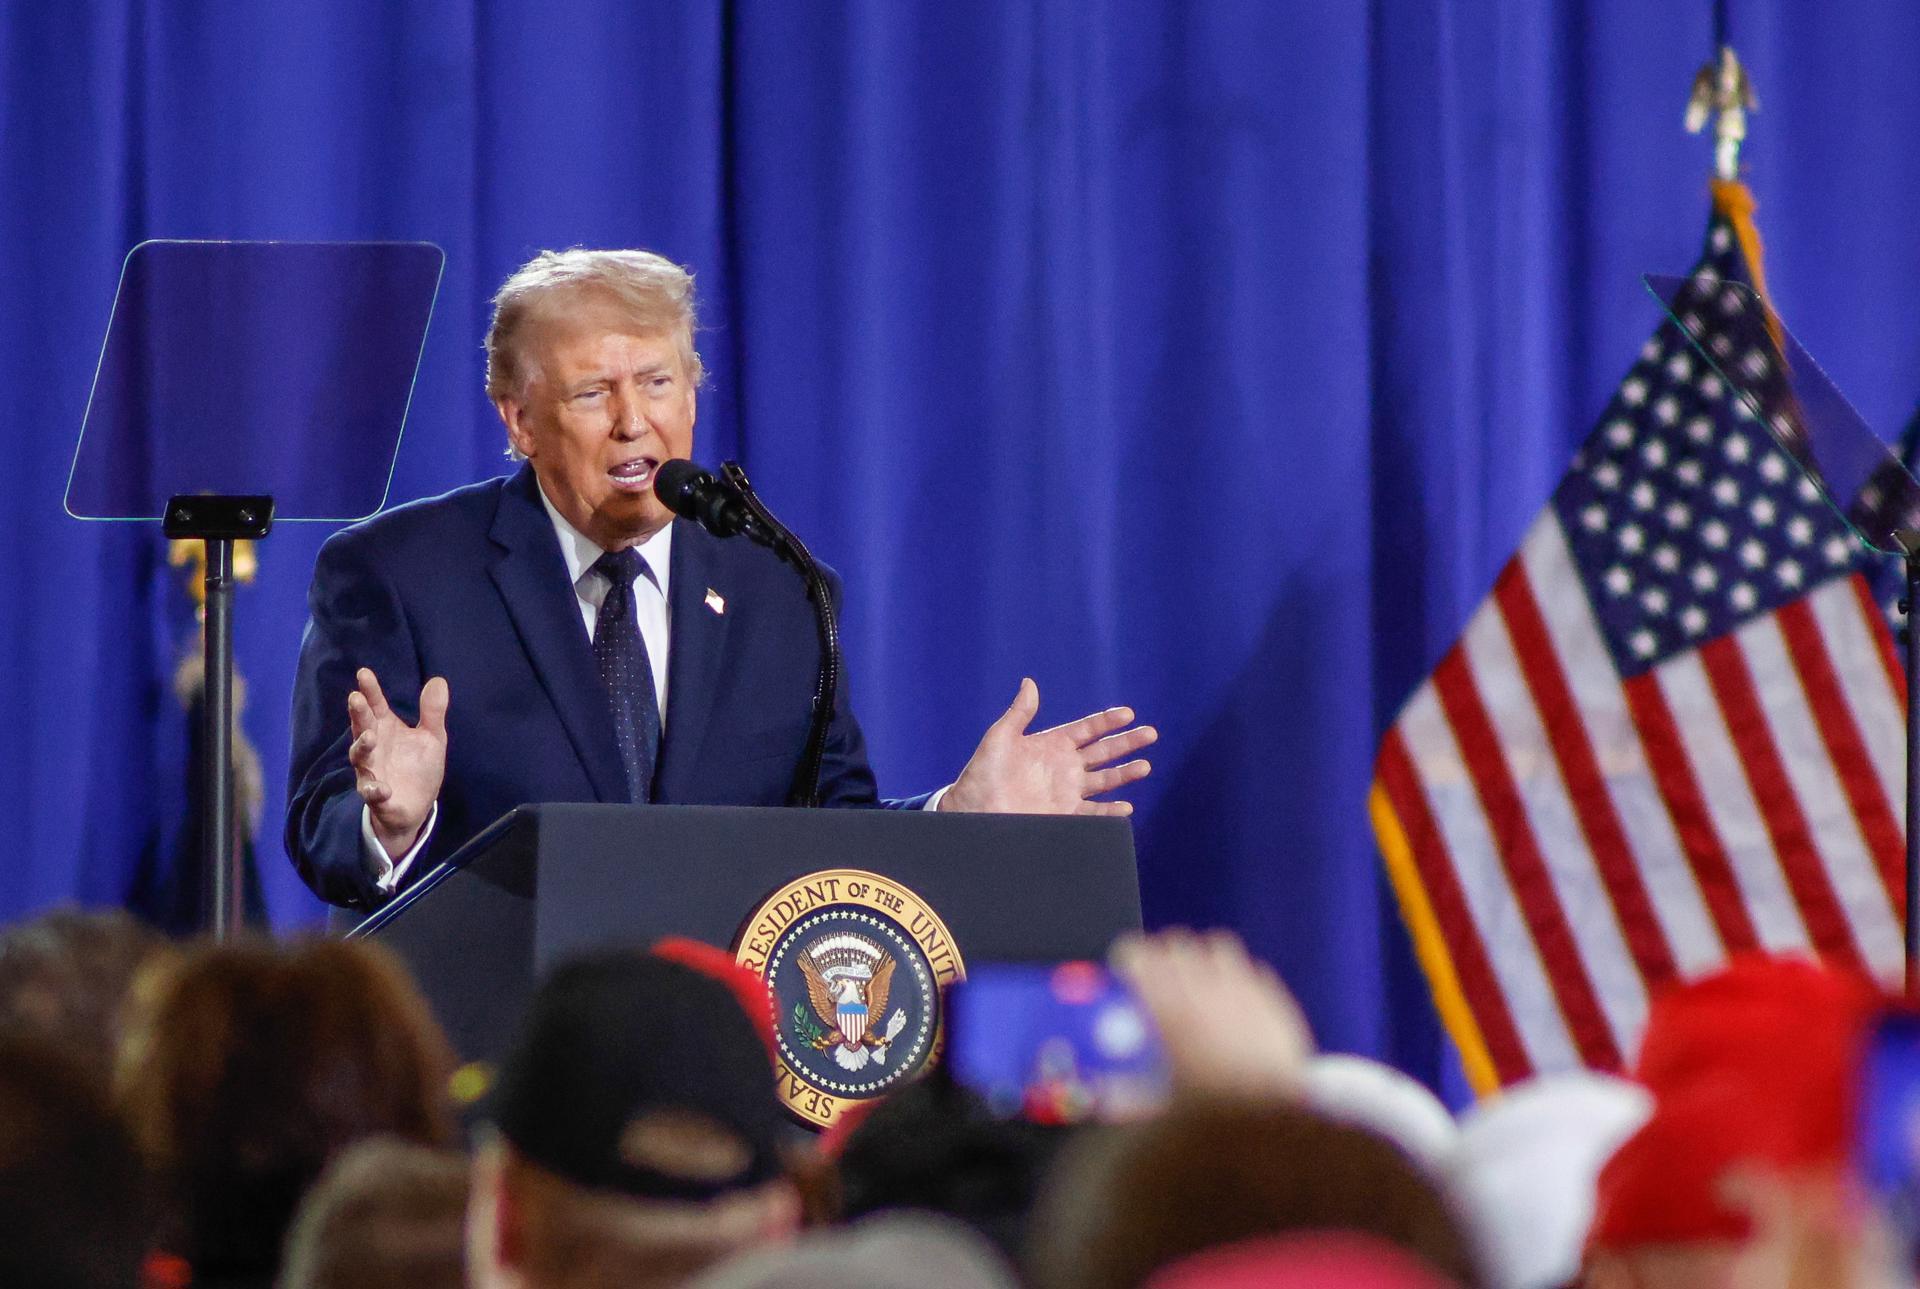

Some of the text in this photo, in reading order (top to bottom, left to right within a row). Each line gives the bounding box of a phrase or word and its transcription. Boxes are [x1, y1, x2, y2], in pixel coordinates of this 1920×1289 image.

[743, 879, 957, 979] RESIDENT OF THE UNIT
[776, 1064, 834, 1119] SEAL
